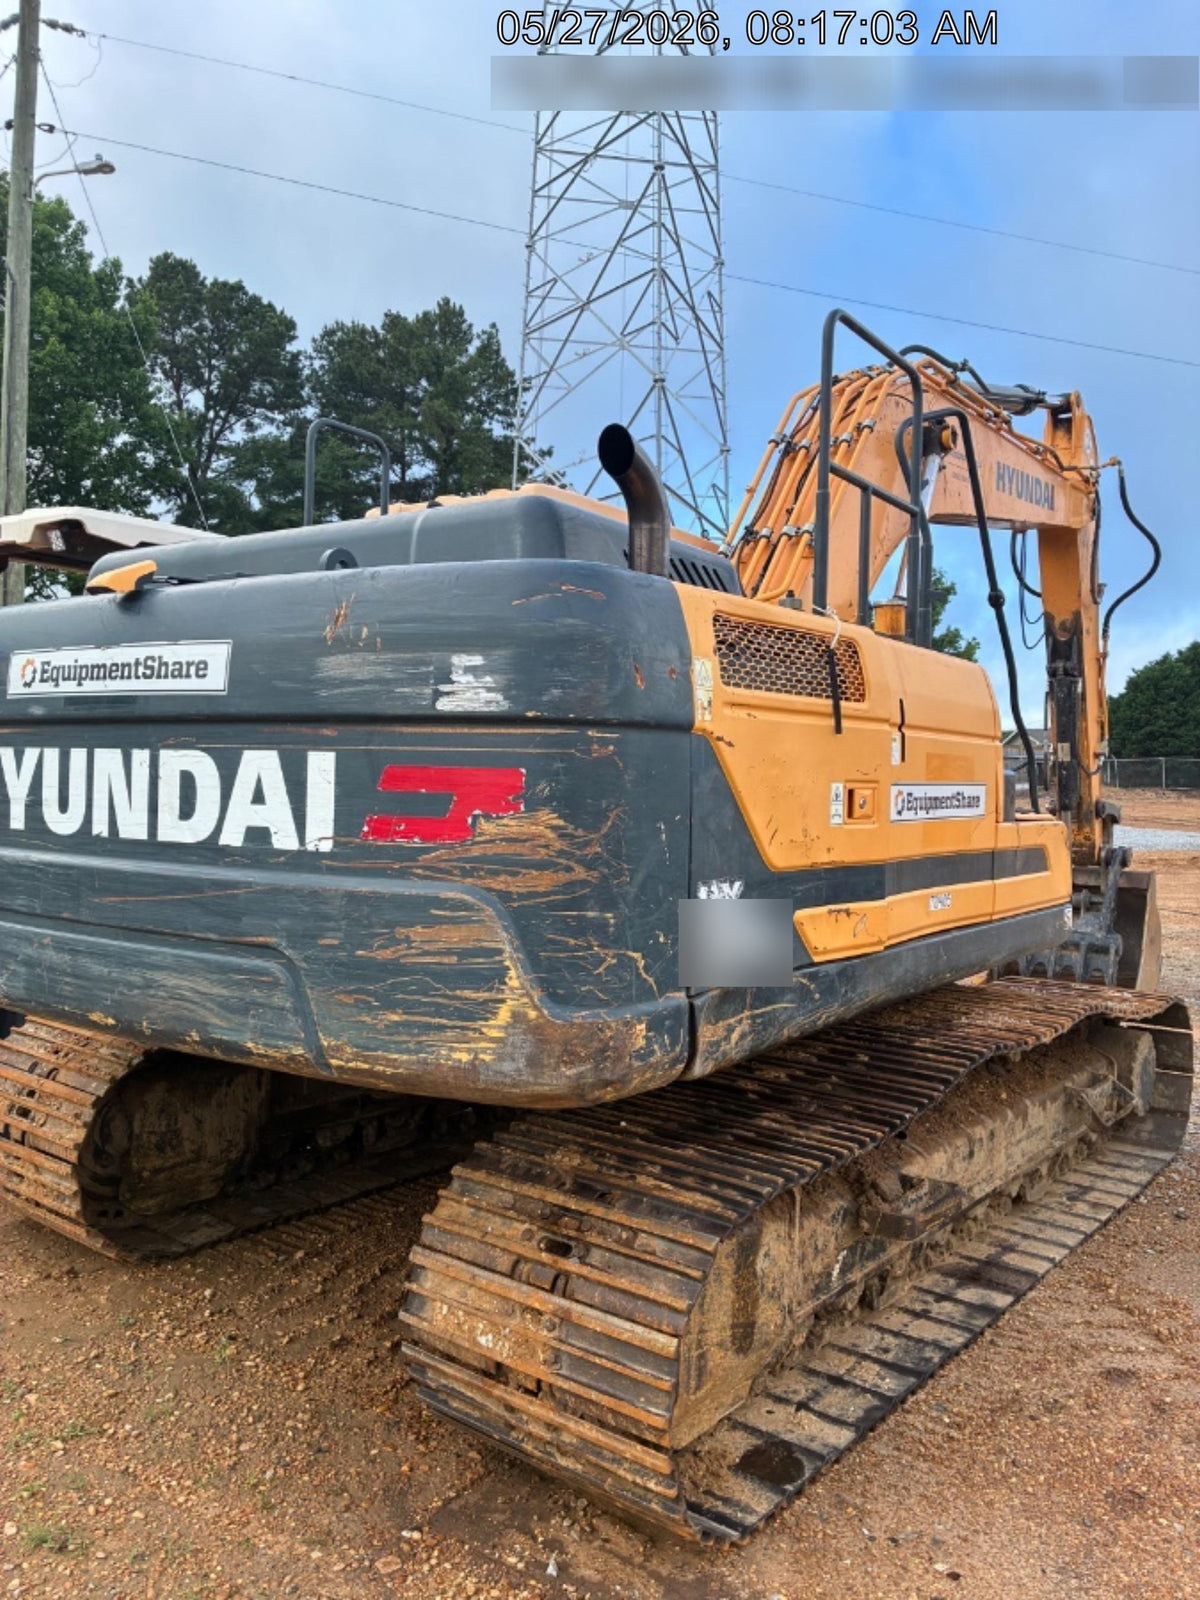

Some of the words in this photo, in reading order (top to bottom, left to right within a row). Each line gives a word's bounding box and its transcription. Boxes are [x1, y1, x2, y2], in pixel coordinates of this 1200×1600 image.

[995, 461, 1055, 511] HYUNDAI
[39, 656, 208, 688] EquipmentShare
[906, 791, 980, 815] EquipmentShare
